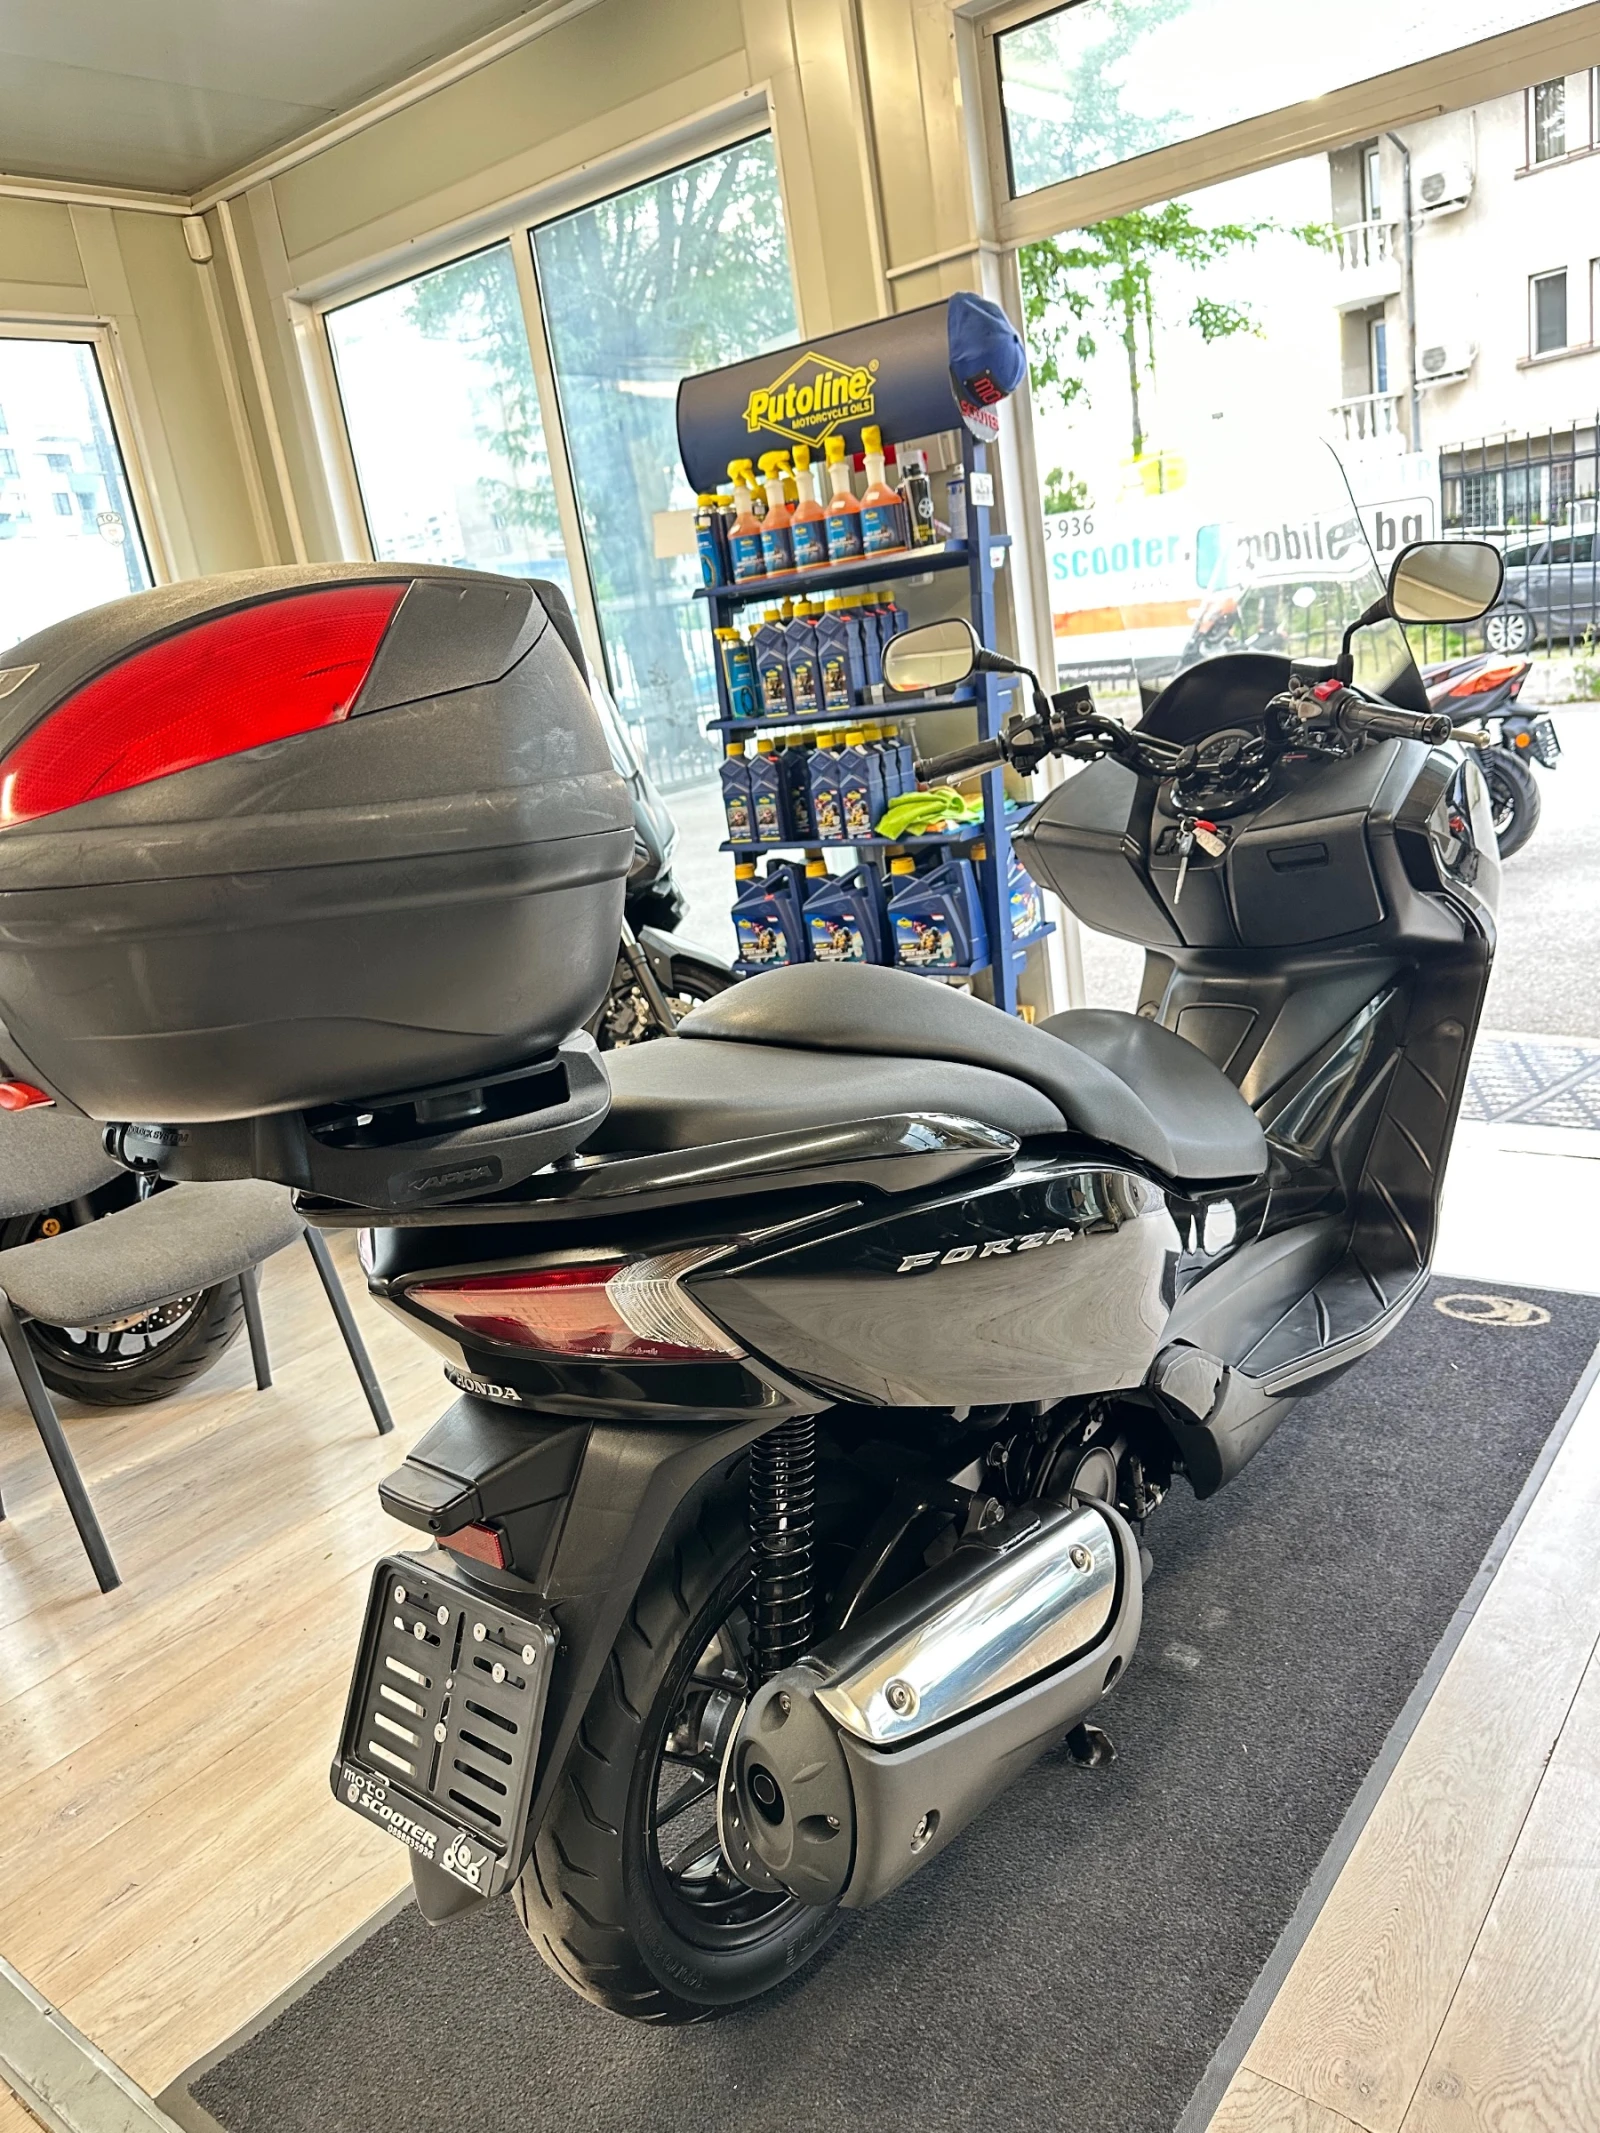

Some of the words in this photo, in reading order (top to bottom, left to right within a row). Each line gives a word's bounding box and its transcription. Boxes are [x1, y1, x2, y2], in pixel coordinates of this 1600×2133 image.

[751, 370, 867, 428] Putoline
[792, 406, 848, 430] MOTORCYCLE
[850, 400, 870, 415] OILS
[1058, 514, 1094, 539] 936
[897, 1227, 1075, 1273] FORZA
[456, 1373, 523, 1401] HONDA
[343, 1768, 386, 1801] moto
[359, 1793, 438, 1850] SCOOTER
[387, 1824, 435, 1860] 0888835936
